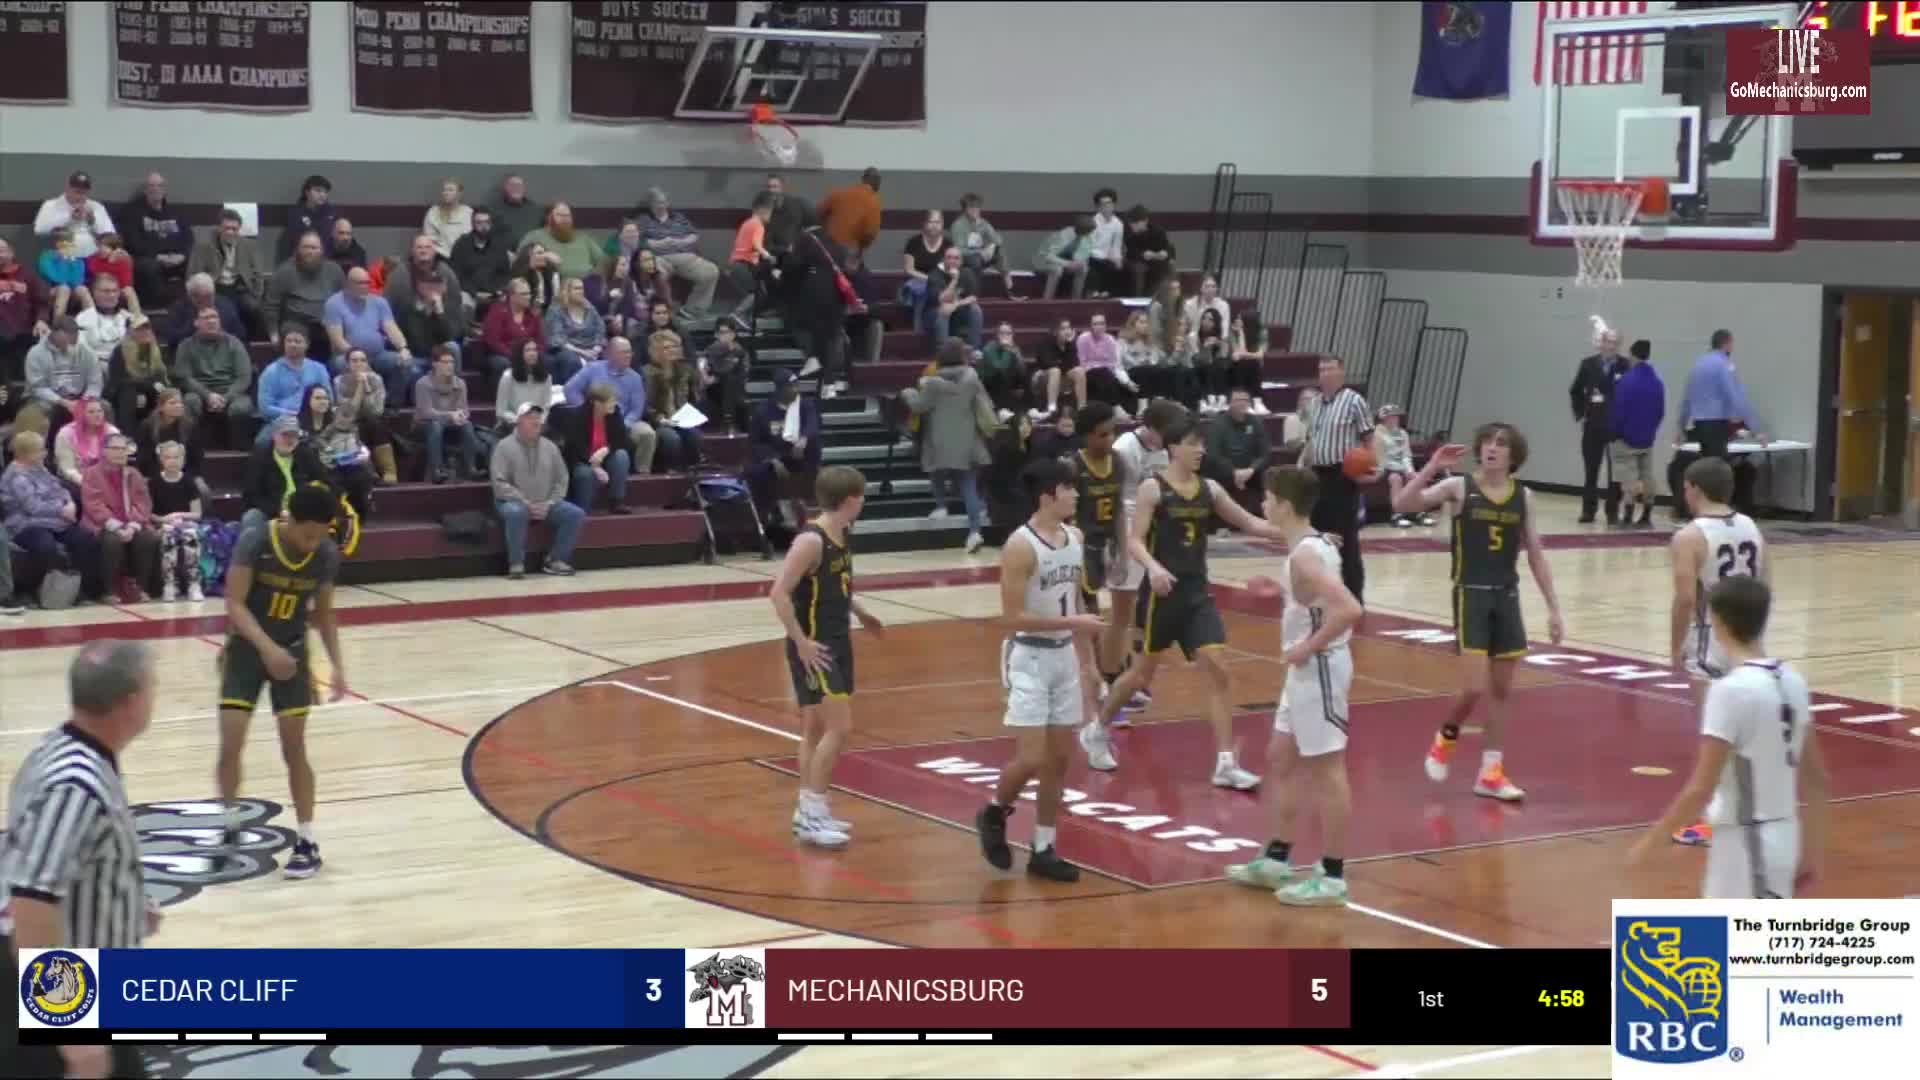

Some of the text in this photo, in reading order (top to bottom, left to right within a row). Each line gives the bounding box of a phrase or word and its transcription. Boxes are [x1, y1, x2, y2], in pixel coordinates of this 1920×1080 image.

[386, 11, 421, 31] PENN
[428, 11, 530, 34] CHAMPIONSHIPS
[600, 21, 633, 40] PENN
[182, 64, 225, 84] AAAA
[229, 66, 308, 88] CHAMPIONS
[1487, 525, 1504, 551] 5
[267, 591, 299, 620] 10
[1057, 591, 1069, 617] 1
